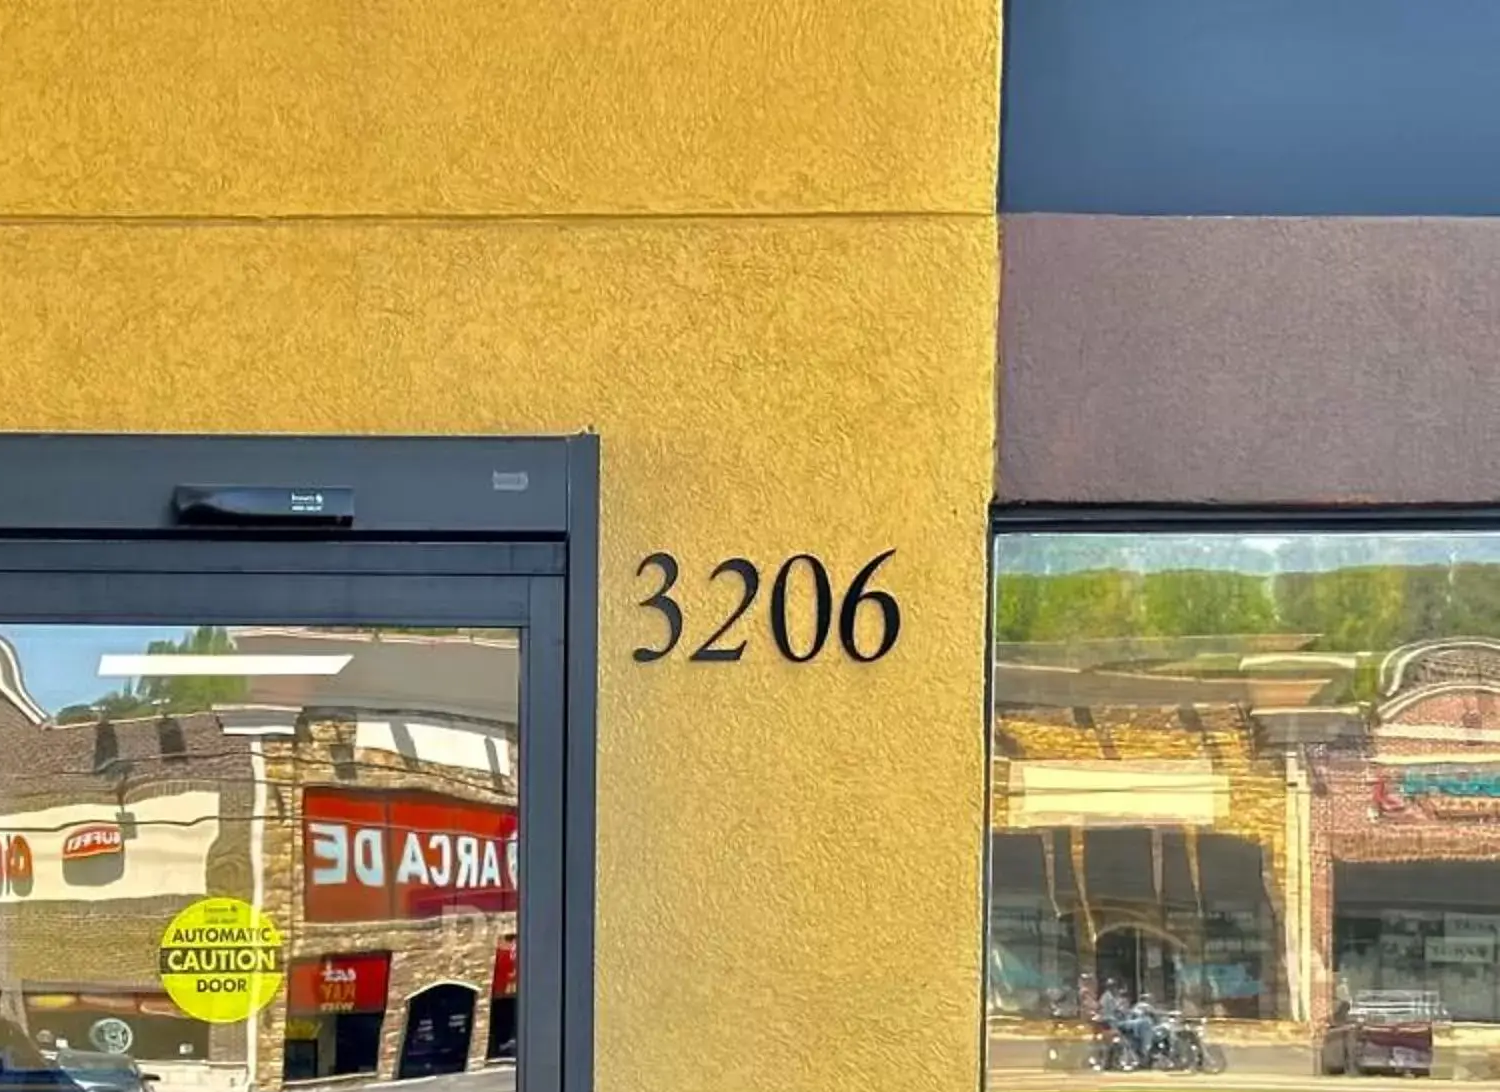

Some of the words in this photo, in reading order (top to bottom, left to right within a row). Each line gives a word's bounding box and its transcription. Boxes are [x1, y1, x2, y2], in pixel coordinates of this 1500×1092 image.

[632, 548, 901, 663] 3206
[172, 928, 272, 943] AUTOMATIC
[167, 949, 276, 971] CAUTION
[196, 978, 247, 993] DOOR
